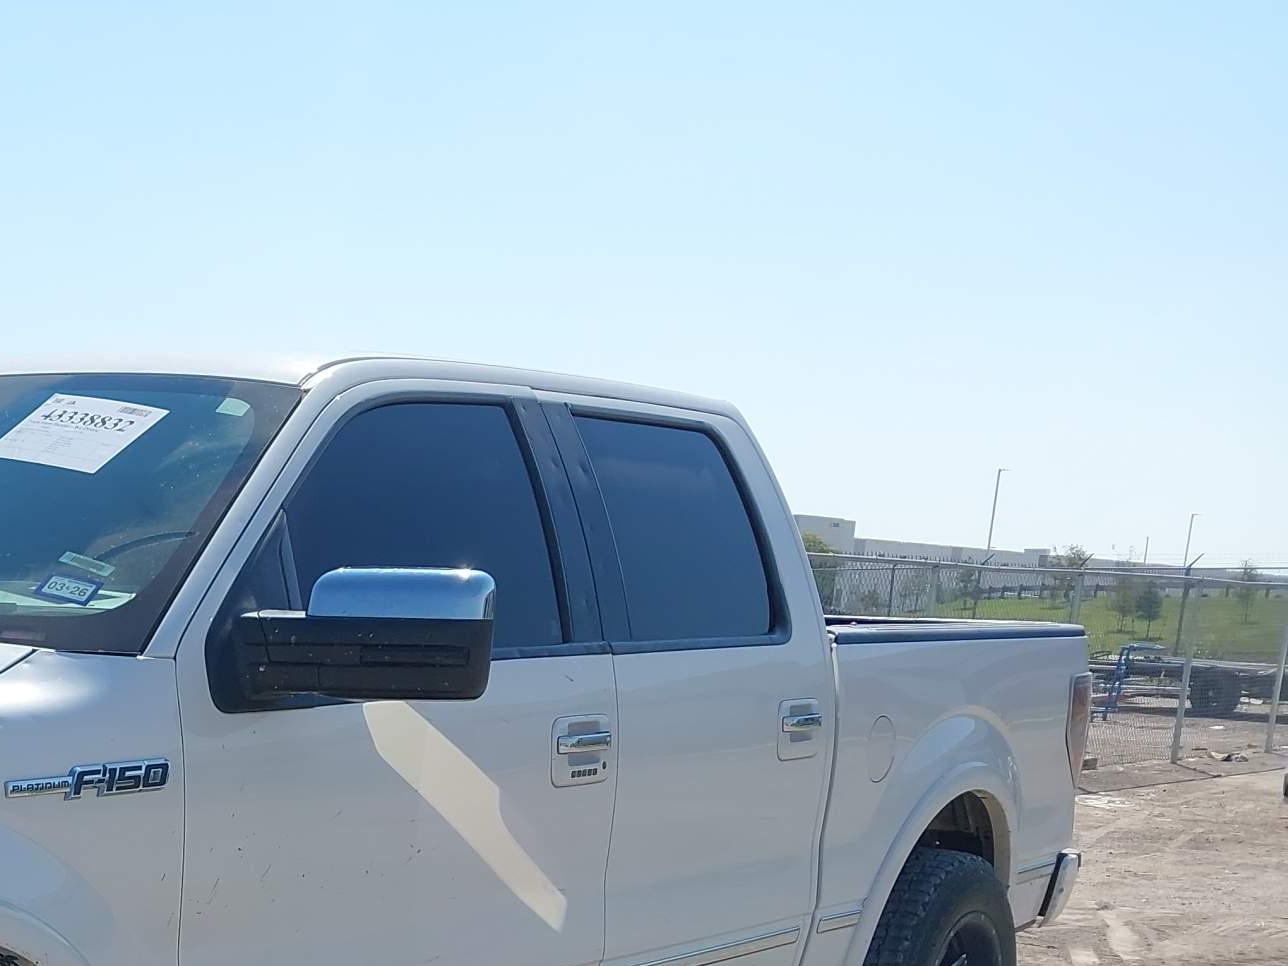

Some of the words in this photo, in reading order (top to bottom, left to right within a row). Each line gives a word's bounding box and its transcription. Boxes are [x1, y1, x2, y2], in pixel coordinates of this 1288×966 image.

[41, 408, 135, 432] 43338832
[47, 581, 66, 592] 03
[69, 586, 89, 597] 26
[10, 780, 71, 794] PLATINUM
[71, 759, 170, 797] F-150
